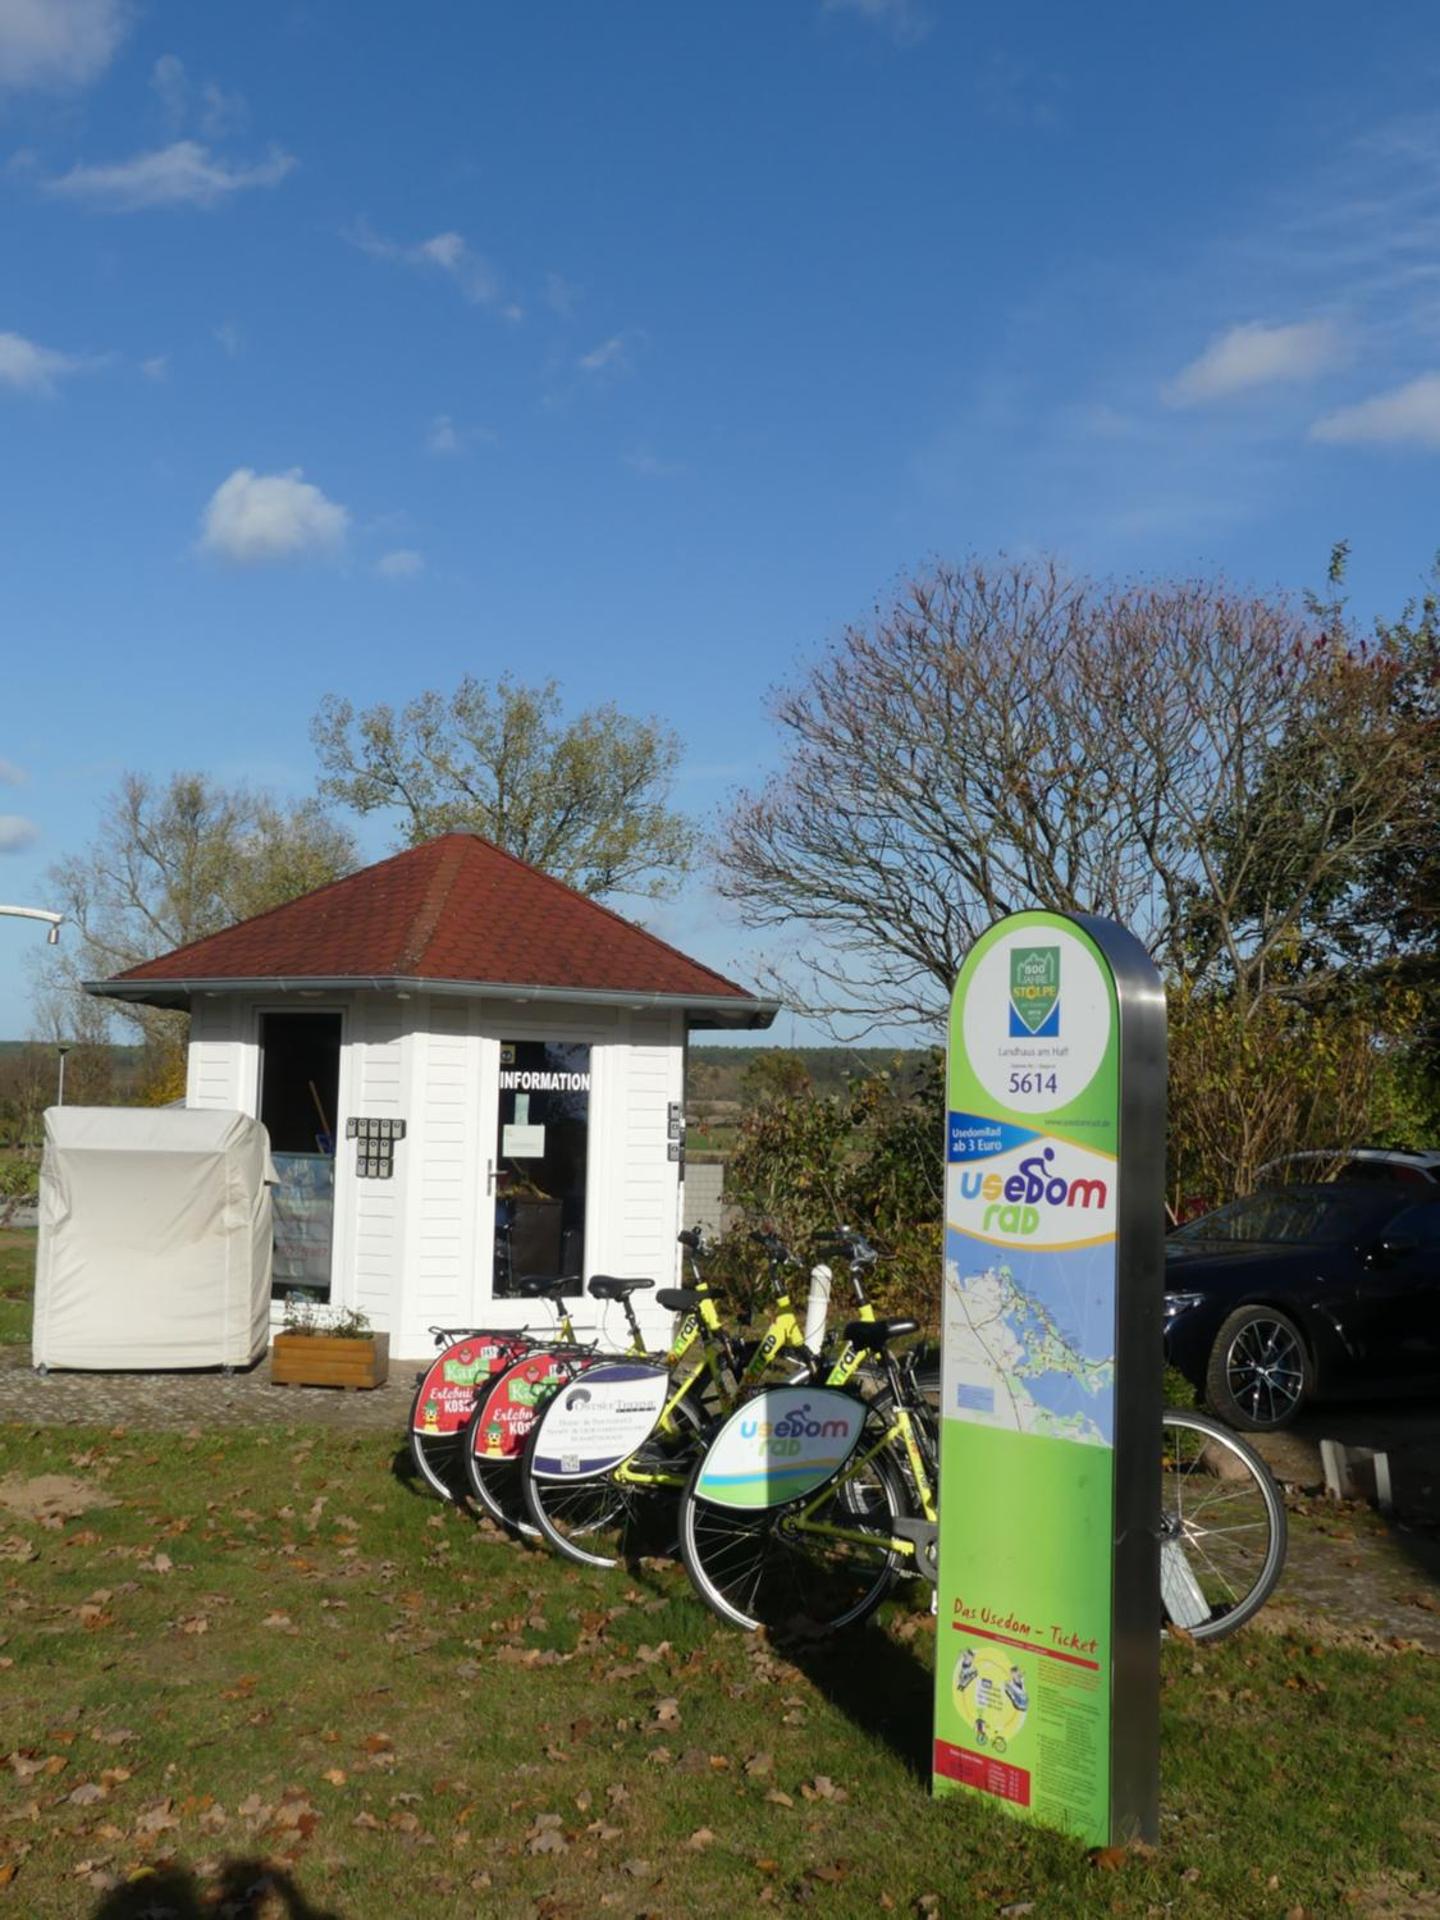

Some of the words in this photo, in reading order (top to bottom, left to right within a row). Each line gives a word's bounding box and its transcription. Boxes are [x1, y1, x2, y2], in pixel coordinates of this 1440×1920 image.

[1013, 985, 1057, 999] STOLPE
[998, 1047, 1035, 1057] Landhaus
[1038, 1049, 1050, 1057] am
[1052, 1047, 1069, 1057] Haff
[499, 1071, 591, 1091] INFORMATION
[1008, 1073, 1057, 1094] 5614
[952, 1126, 1002, 1138] UsedomRad
[952, 1141, 966, 1151] ab
[968, 1140, 975, 1151] 3
[977, 1139, 1002, 1151] Euro
[953, 1597, 976, 1620] Das
[980, 1606, 1031, 1635] Usedom
[1050, 1625, 1099, 1654] Ticket
